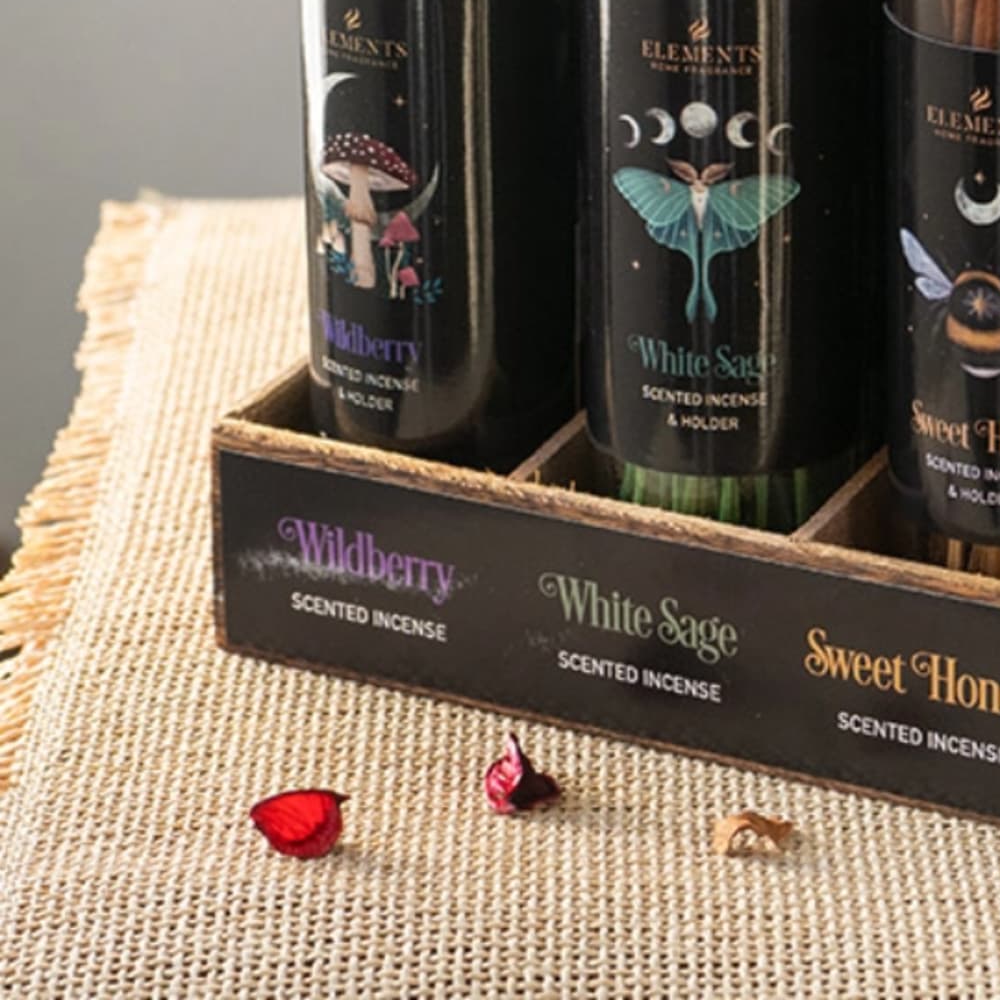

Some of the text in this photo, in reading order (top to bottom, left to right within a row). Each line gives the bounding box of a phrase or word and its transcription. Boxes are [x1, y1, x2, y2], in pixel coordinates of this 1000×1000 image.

[325, 28, 409, 58] LEMENTS
[640, 39, 762, 63] ELEMENTS
[627, 333, 710, 378] White
[641, 384, 768, 407] SCENTED INCENSE
[667, 412, 739, 431] & HOLDER
[911, 399, 970, 449] Sweet
[925, 452, 981, 480] SCENTED
[947, 484, 958, 499] &
[278, 516, 455, 606] Wildberry
[291, 592, 448, 642] SCENTED INCENSE
[539, 572, 739, 664] White Sage
[558, 650, 722, 702] SCENTED INCENSE
[804, 627, 908, 694] Sweet
[837, 711, 923, 747] SCENTED
